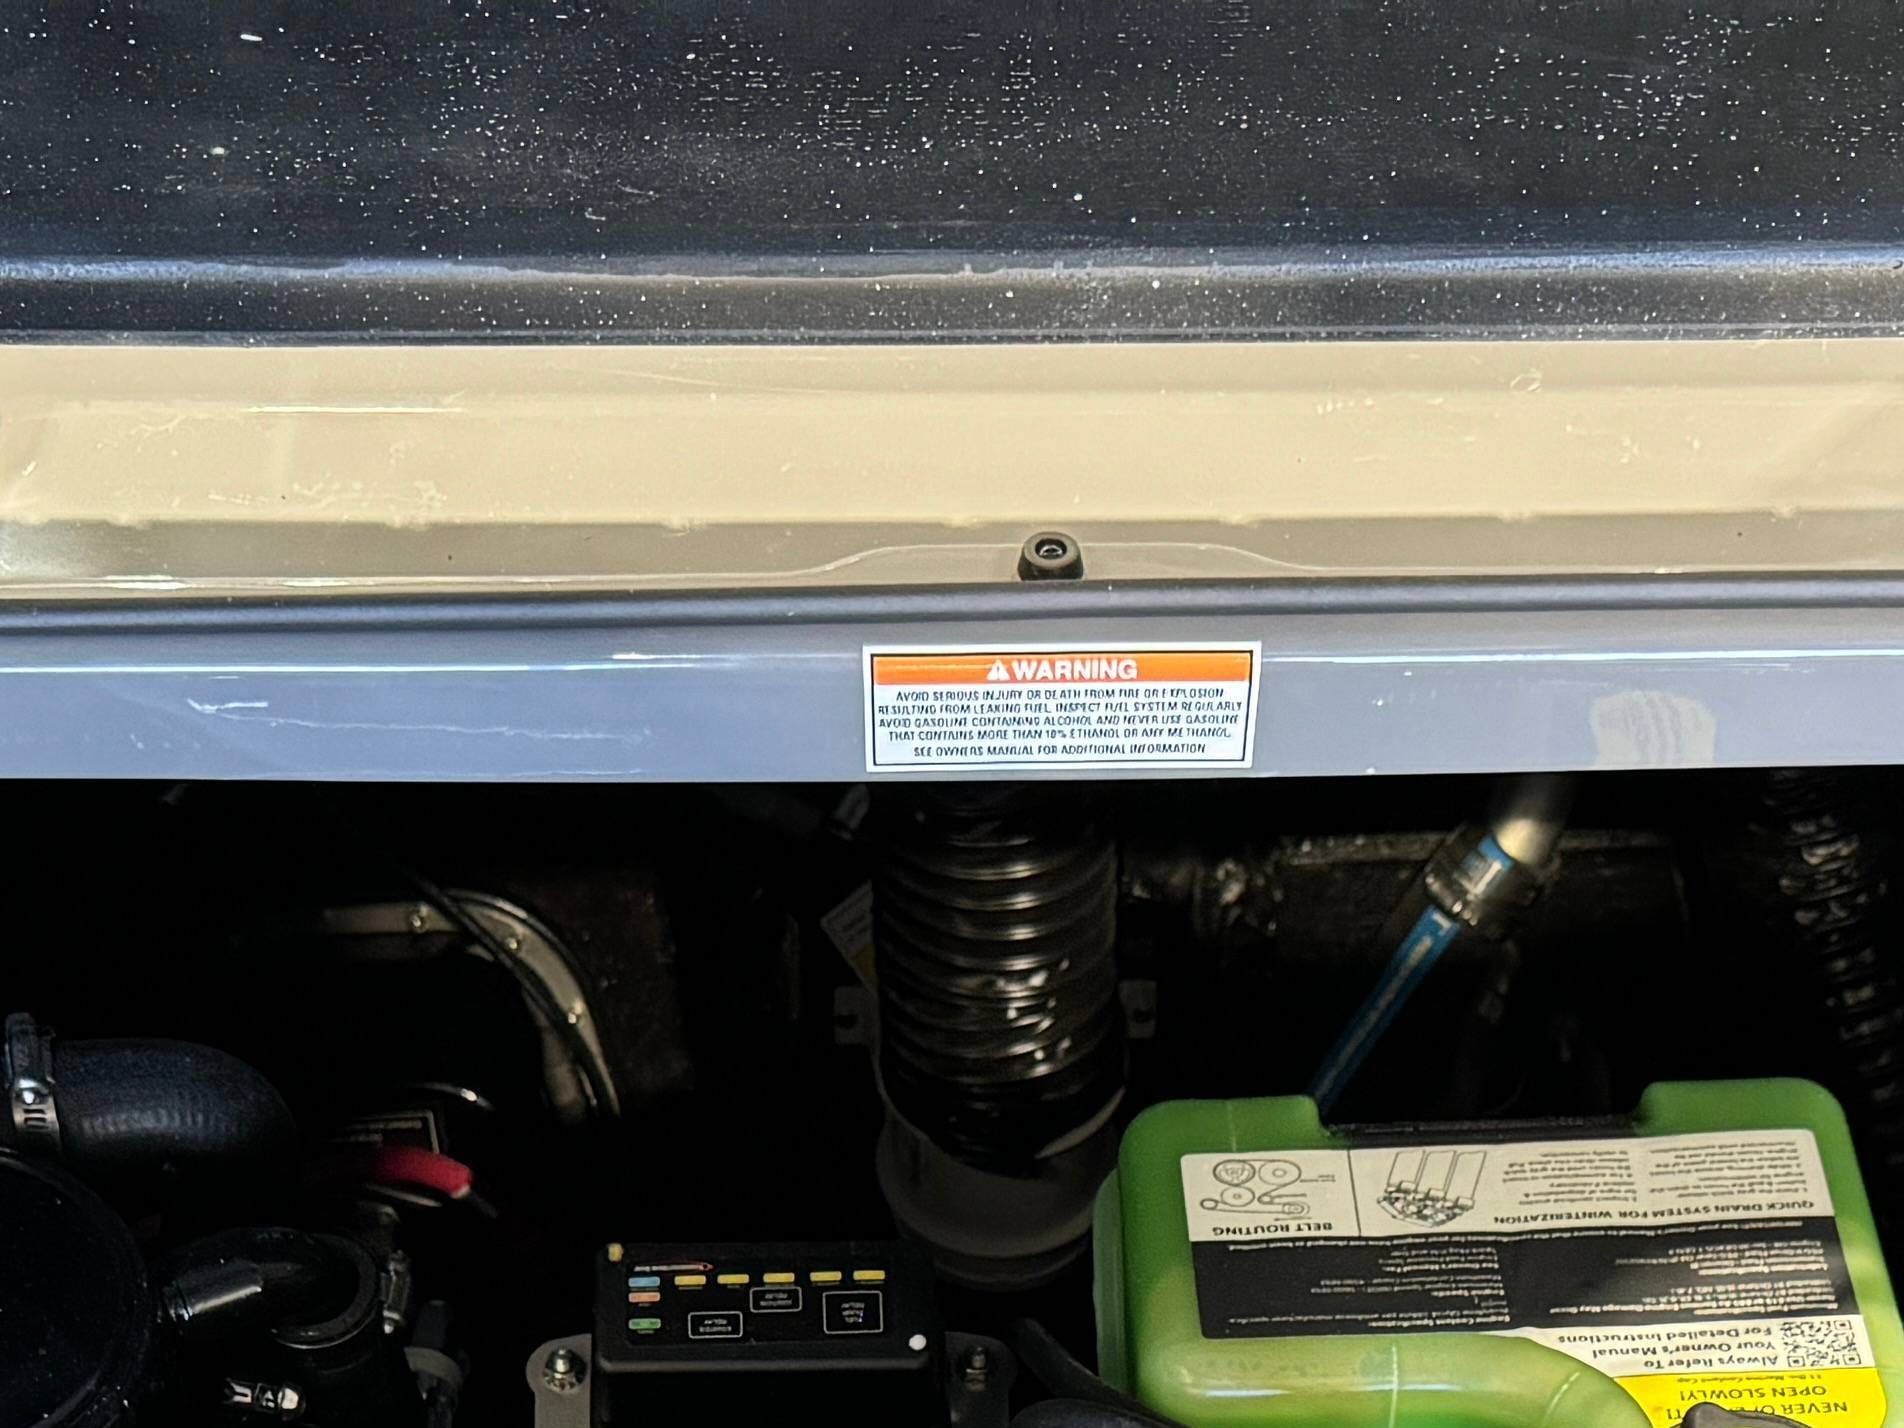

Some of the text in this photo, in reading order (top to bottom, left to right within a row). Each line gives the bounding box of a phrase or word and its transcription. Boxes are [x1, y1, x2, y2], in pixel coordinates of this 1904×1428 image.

[1011, 659, 1137, 680] WARNING
[1666, 1328, 1739, 1341] Detailed
[1744, 1327, 1772, 1337] For
[1737, 1341, 1776, 1351] Your
[1591, 1347, 1657, 1359] Manual
[1644, 1360, 1665, 1370] To
[1718, 1354, 1778, 1366] Always
[1680, 1386, 1827, 1401] OPEN SLOWLY!
[1781, 1402, 1848, 1415] NEVER
